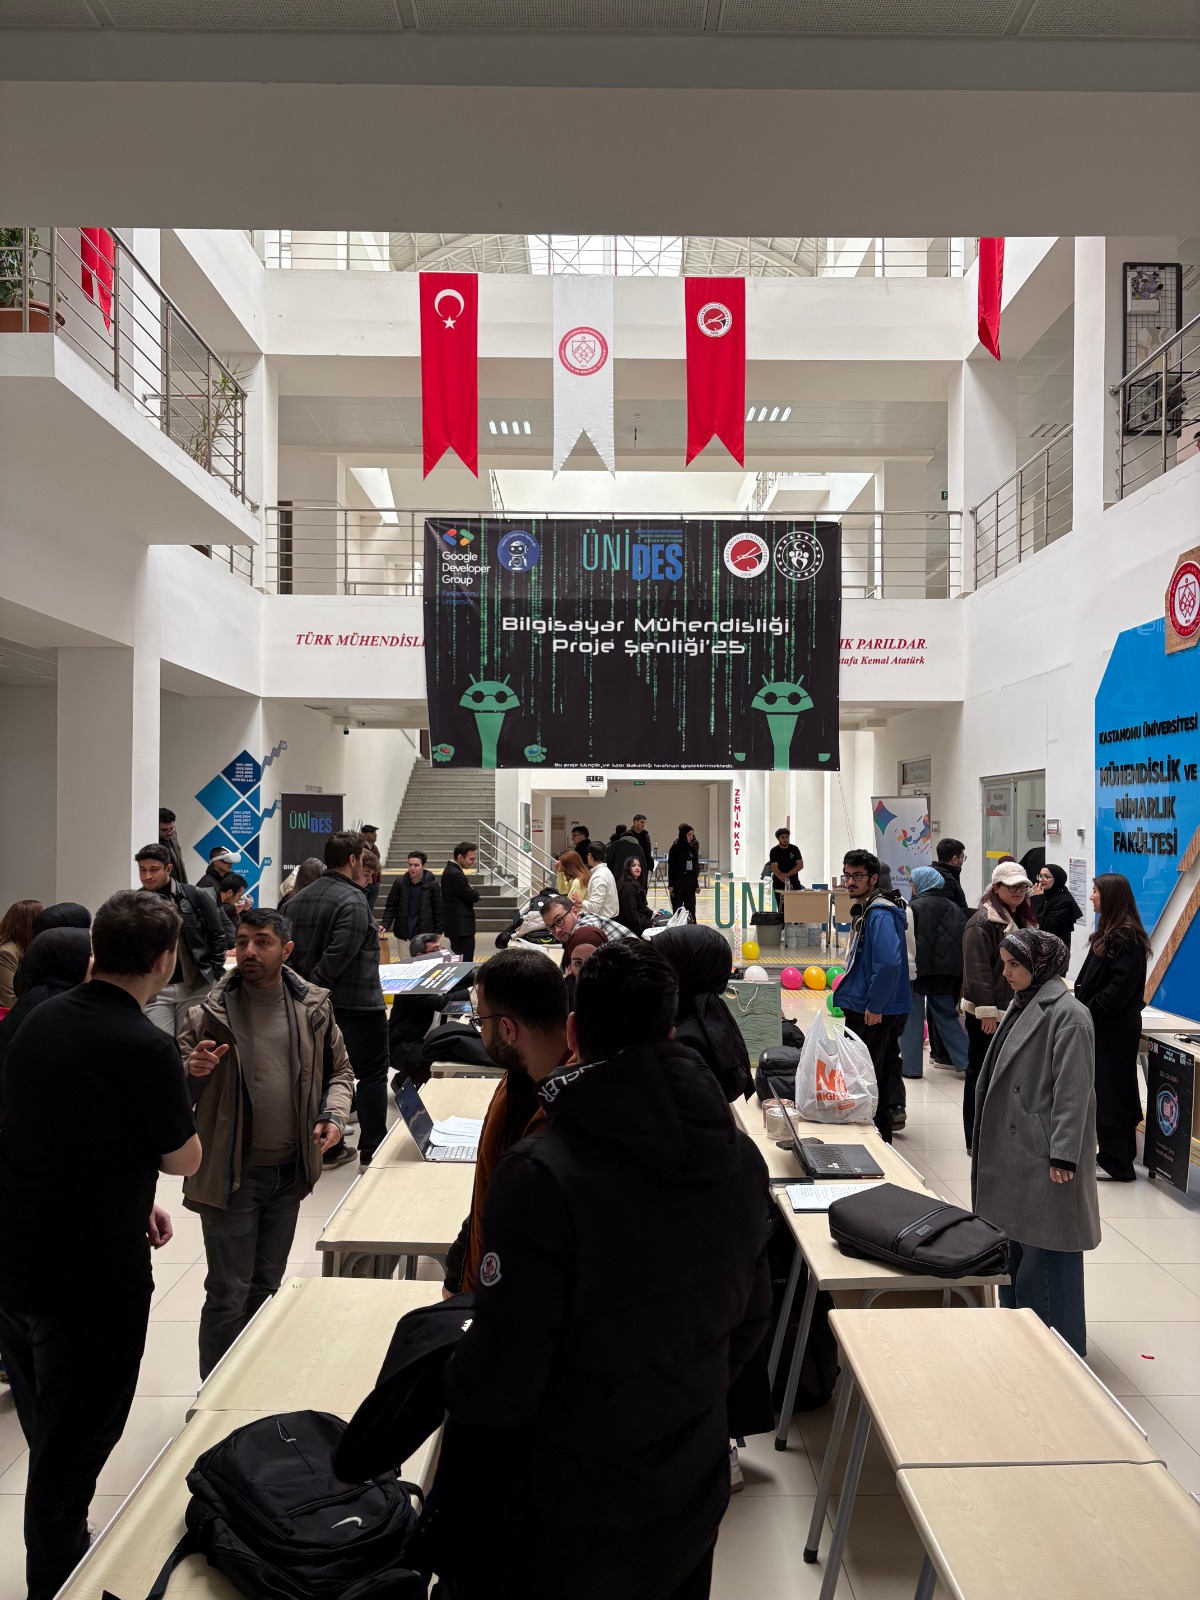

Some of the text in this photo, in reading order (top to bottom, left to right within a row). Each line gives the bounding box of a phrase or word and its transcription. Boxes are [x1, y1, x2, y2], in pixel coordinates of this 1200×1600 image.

[442, 551, 478, 563] Google
[583, 529, 629, 571] ÜNİ
[726, 534, 745, 563] KASTAMONU
[442, 563, 491, 575] Developer
[632, 544, 683, 580] DES
[442, 575, 473, 587] Group
[442, 588, 479, 596] Kastamonu
[502, 616, 789, 636] Bilgisayar Mühendisliği
[296, 631, 334, 646] TÜRK
[552, 637, 745, 657] Proje Şenliği'25
[839, 638, 928, 650] IK PARILDAR.
[860, 656, 890, 665] Kemal
[891, 656, 925, 665] Atatürk
[1099, 712, 1198, 745] KASTAMONU ÜNİVERSİTESİ
[1099, 754, 1198, 788] MÜHENDİSLİK VE
[1115, 793, 1177, 820] MİMARLIK
[289, 810, 310, 829] ÜNİ
[310, 817, 333, 833] DES
[1113, 827, 1178, 856] FAKÜLTESİ
